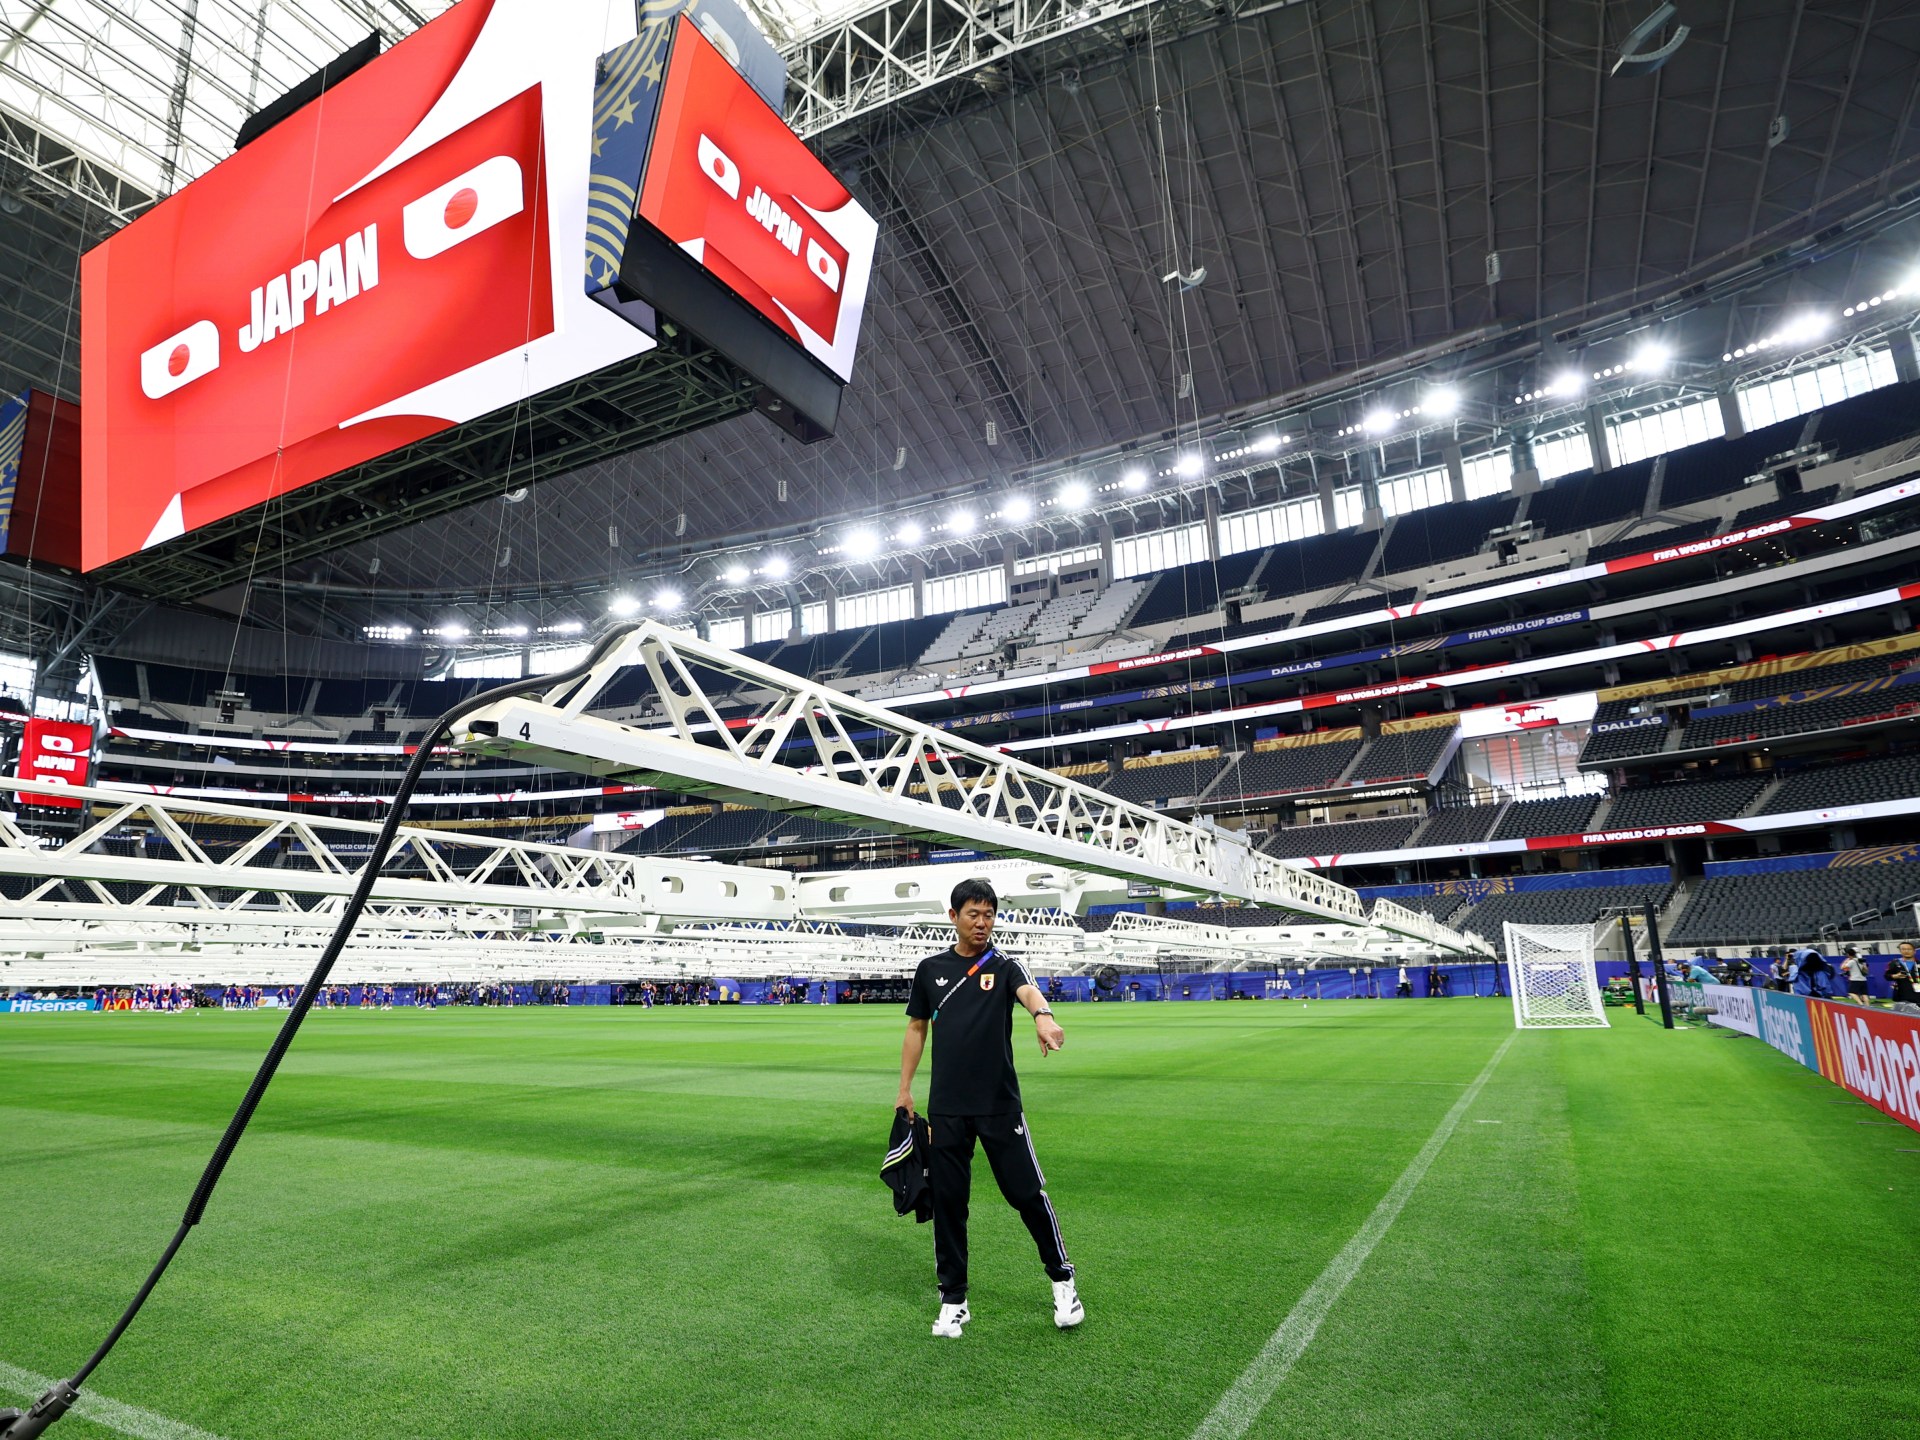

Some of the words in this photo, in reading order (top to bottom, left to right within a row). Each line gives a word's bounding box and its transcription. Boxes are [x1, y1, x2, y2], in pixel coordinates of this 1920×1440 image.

[745, 185, 803, 257] JAPAN
[238, 222, 379, 353] JAPAN
[1653, 549, 1679, 561] FIFA
[1679, 538, 1721, 555] WORLD
[1721, 532, 1747, 545] CUP
[1747, 519, 1793, 539] 2026
[1468, 630, 1489, 640] FIFA
[1490, 622, 1524, 636] WORLD
[1525, 618, 1545, 629] CUP
[1546, 611, 1582, 625] 2026
[1118, 659, 1134, 669] FIFA
[1134, 655, 1160, 667] WORLD
[1161, 652, 1176, 662] CUP
[1271, 660, 1322, 676] DALLAS
[1335, 693, 1354, 703] FIFA
[1354, 688, 1382, 700] WORLD
[1382, 686, 1399, 696] CUP
[519, 721, 531, 741] 4
[1597, 716, 1663, 733] DALLAS
[33, 755, 76, 771] JAPAN
[1582, 833, 1606, 844] FIFA
[1606, 830, 1643, 842] WORLD
[1643, 828, 1666, 838] CUP
[1666, 824, 1706, 836] 2026
[1265, 980, 1292, 990] FIFA
[10, 999, 87, 1012] Hisense
[1757, 989, 1806, 1066] Hisense
